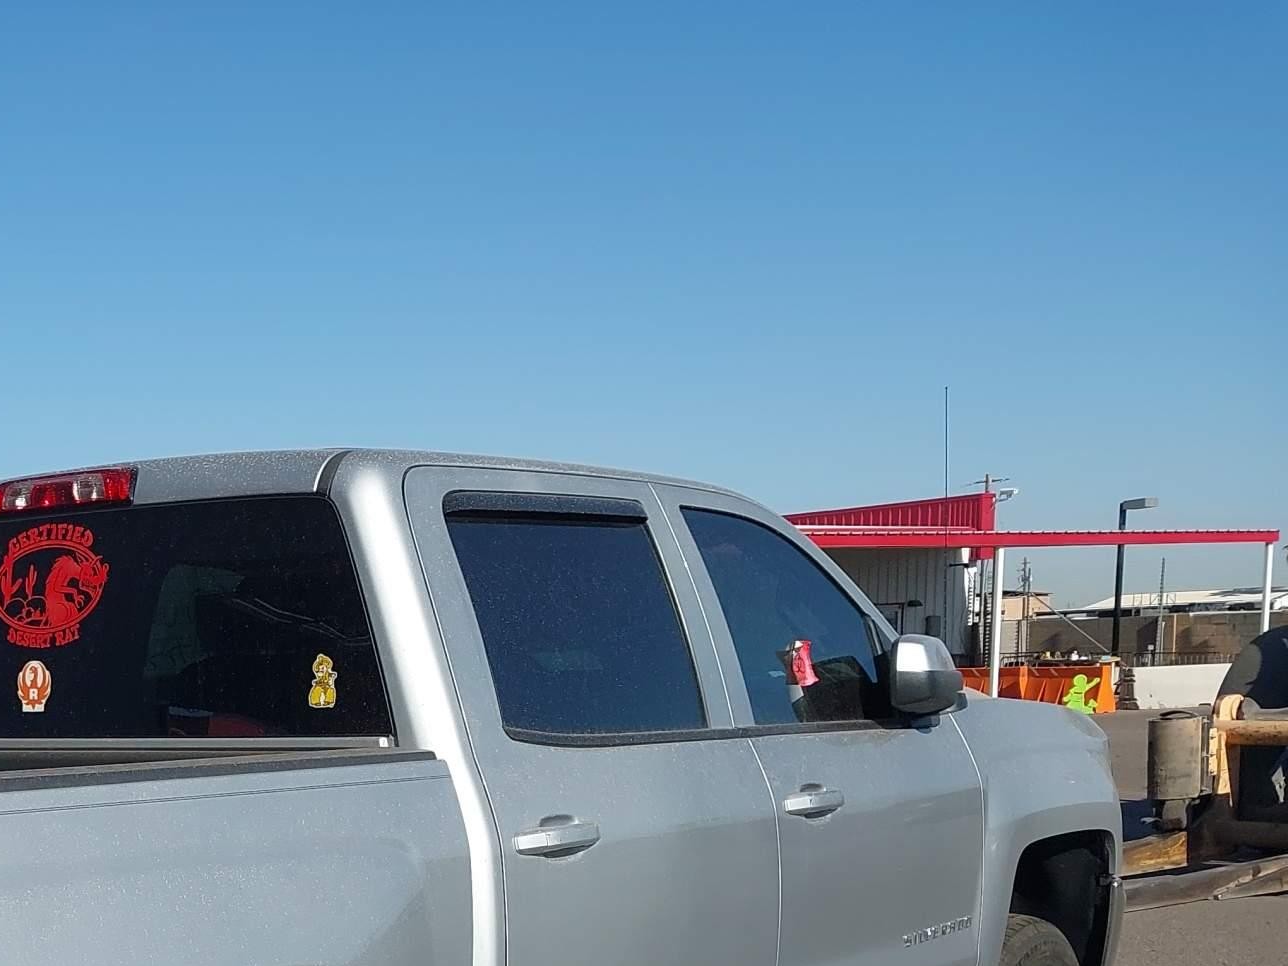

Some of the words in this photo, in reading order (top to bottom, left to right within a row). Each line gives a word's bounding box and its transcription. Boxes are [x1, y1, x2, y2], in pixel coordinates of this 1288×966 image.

[8, 523, 94, 551] CERTIFIED
[7, 629, 53, 648] DESERT
[55, 624, 80, 646] RAT
